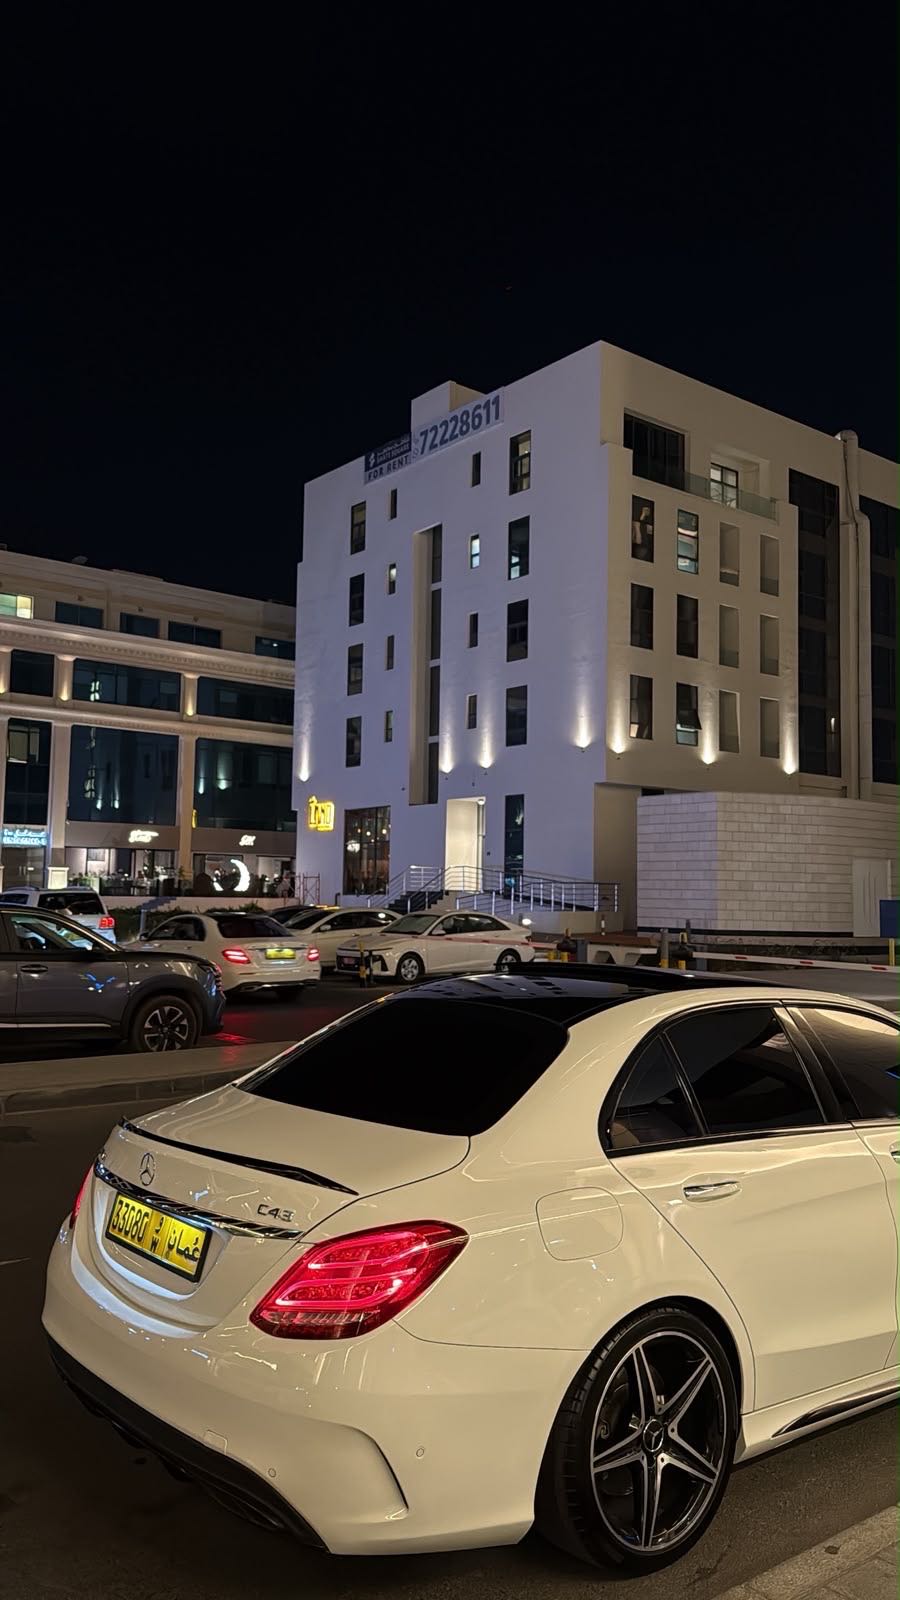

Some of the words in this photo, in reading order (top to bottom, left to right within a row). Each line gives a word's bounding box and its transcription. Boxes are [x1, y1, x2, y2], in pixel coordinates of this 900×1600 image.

[420, 395, 500, 455] 72228611
[368, 466, 383, 481] FOR
[387, 455, 408, 473] RENT
[112, 1199, 150, 1243] 33080
[257, 1203, 294, 1222] C43
[151, 1236, 160, 1253] W
